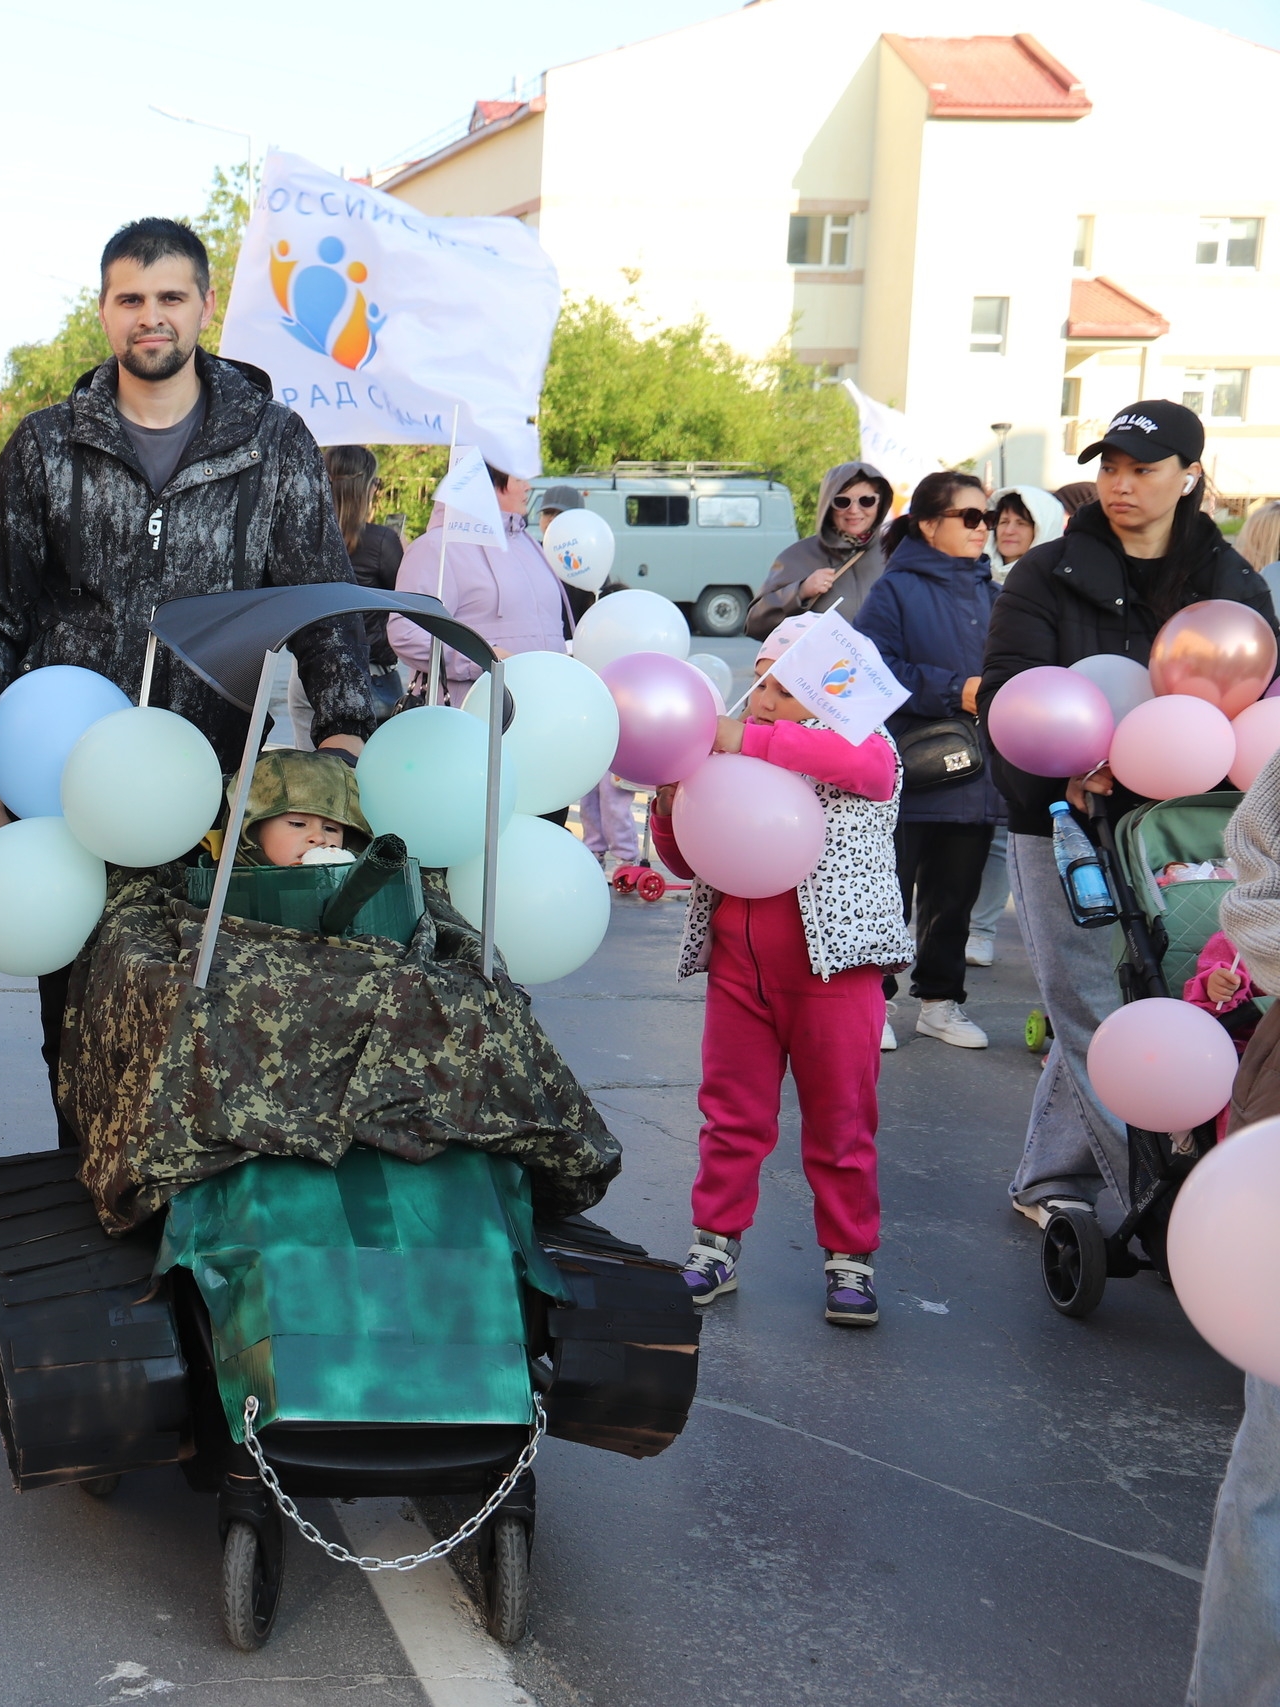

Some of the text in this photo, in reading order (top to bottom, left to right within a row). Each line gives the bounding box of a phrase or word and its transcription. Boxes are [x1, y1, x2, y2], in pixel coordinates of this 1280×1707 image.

[1127, 413, 1159, 434] LUCK
[553, 538, 579, 551] ПАРАД
[831, 629, 894, 698] ВСЕРОССИЙСКИЙ
[795, 677, 851, 724] ПАРАД СЕМЬИ
